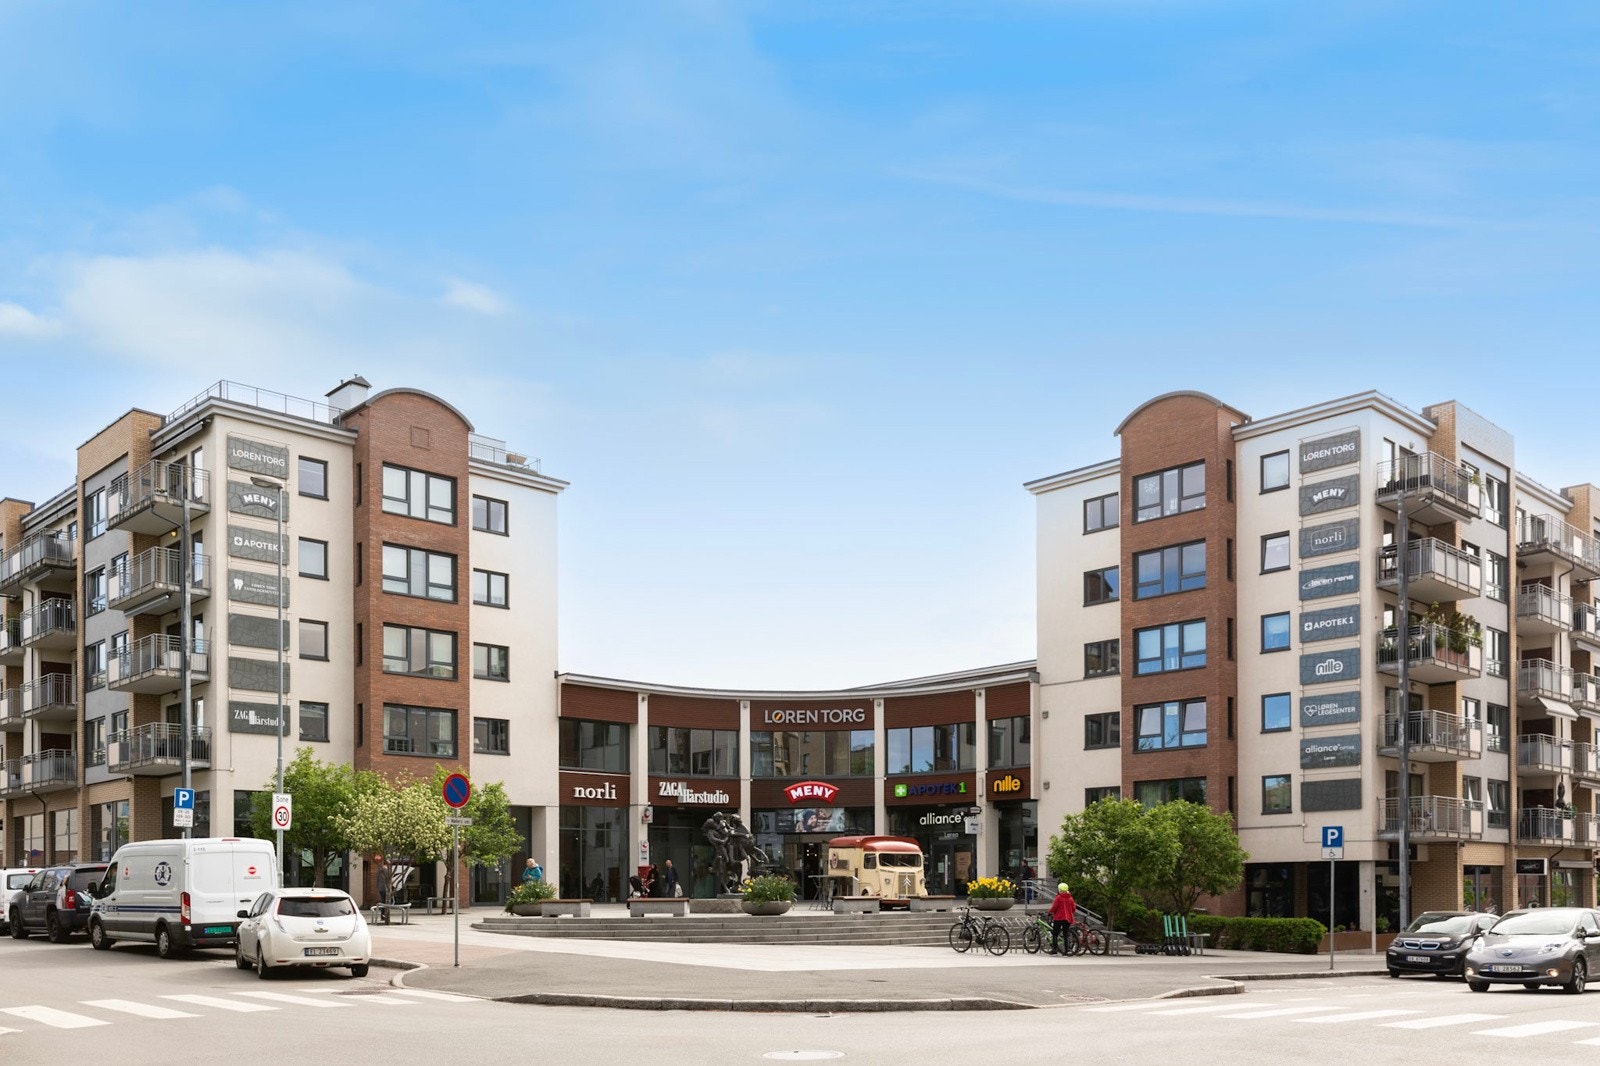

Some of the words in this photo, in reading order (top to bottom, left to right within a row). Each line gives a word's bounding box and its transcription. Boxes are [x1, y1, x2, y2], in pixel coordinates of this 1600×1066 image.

[1331, 442, 1355, 455] TORG
[262, 454, 285, 467] TORG
[243, 494, 276, 508] MENY
[1312, 488, 1345, 503] MENY
[1314, 531, 1342, 545] norli
[243, 539, 279, 552] APOTEK
[1313, 617, 1348, 629] APOTEK
[1348, 616, 1354, 624] 1
[1316, 658, 1343, 676] nille
[821, 708, 866, 723] TORG
[1305, 744, 1338, 754] alliance
[573, 782, 618, 800] norli
[659, 781, 684, 797] ZAGA
[909, 783, 958, 796] APOTEK
[958, 781, 967, 794] 1
[993, 775, 1021, 793] nille
[179, 791, 190, 806] P
[276, 795, 289, 804] Sone
[789, 785, 834, 800] MENY
[278, 811, 288, 822] 30
[919, 812, 963, 826] alliance
[1327, 829, 1338, 845] P
